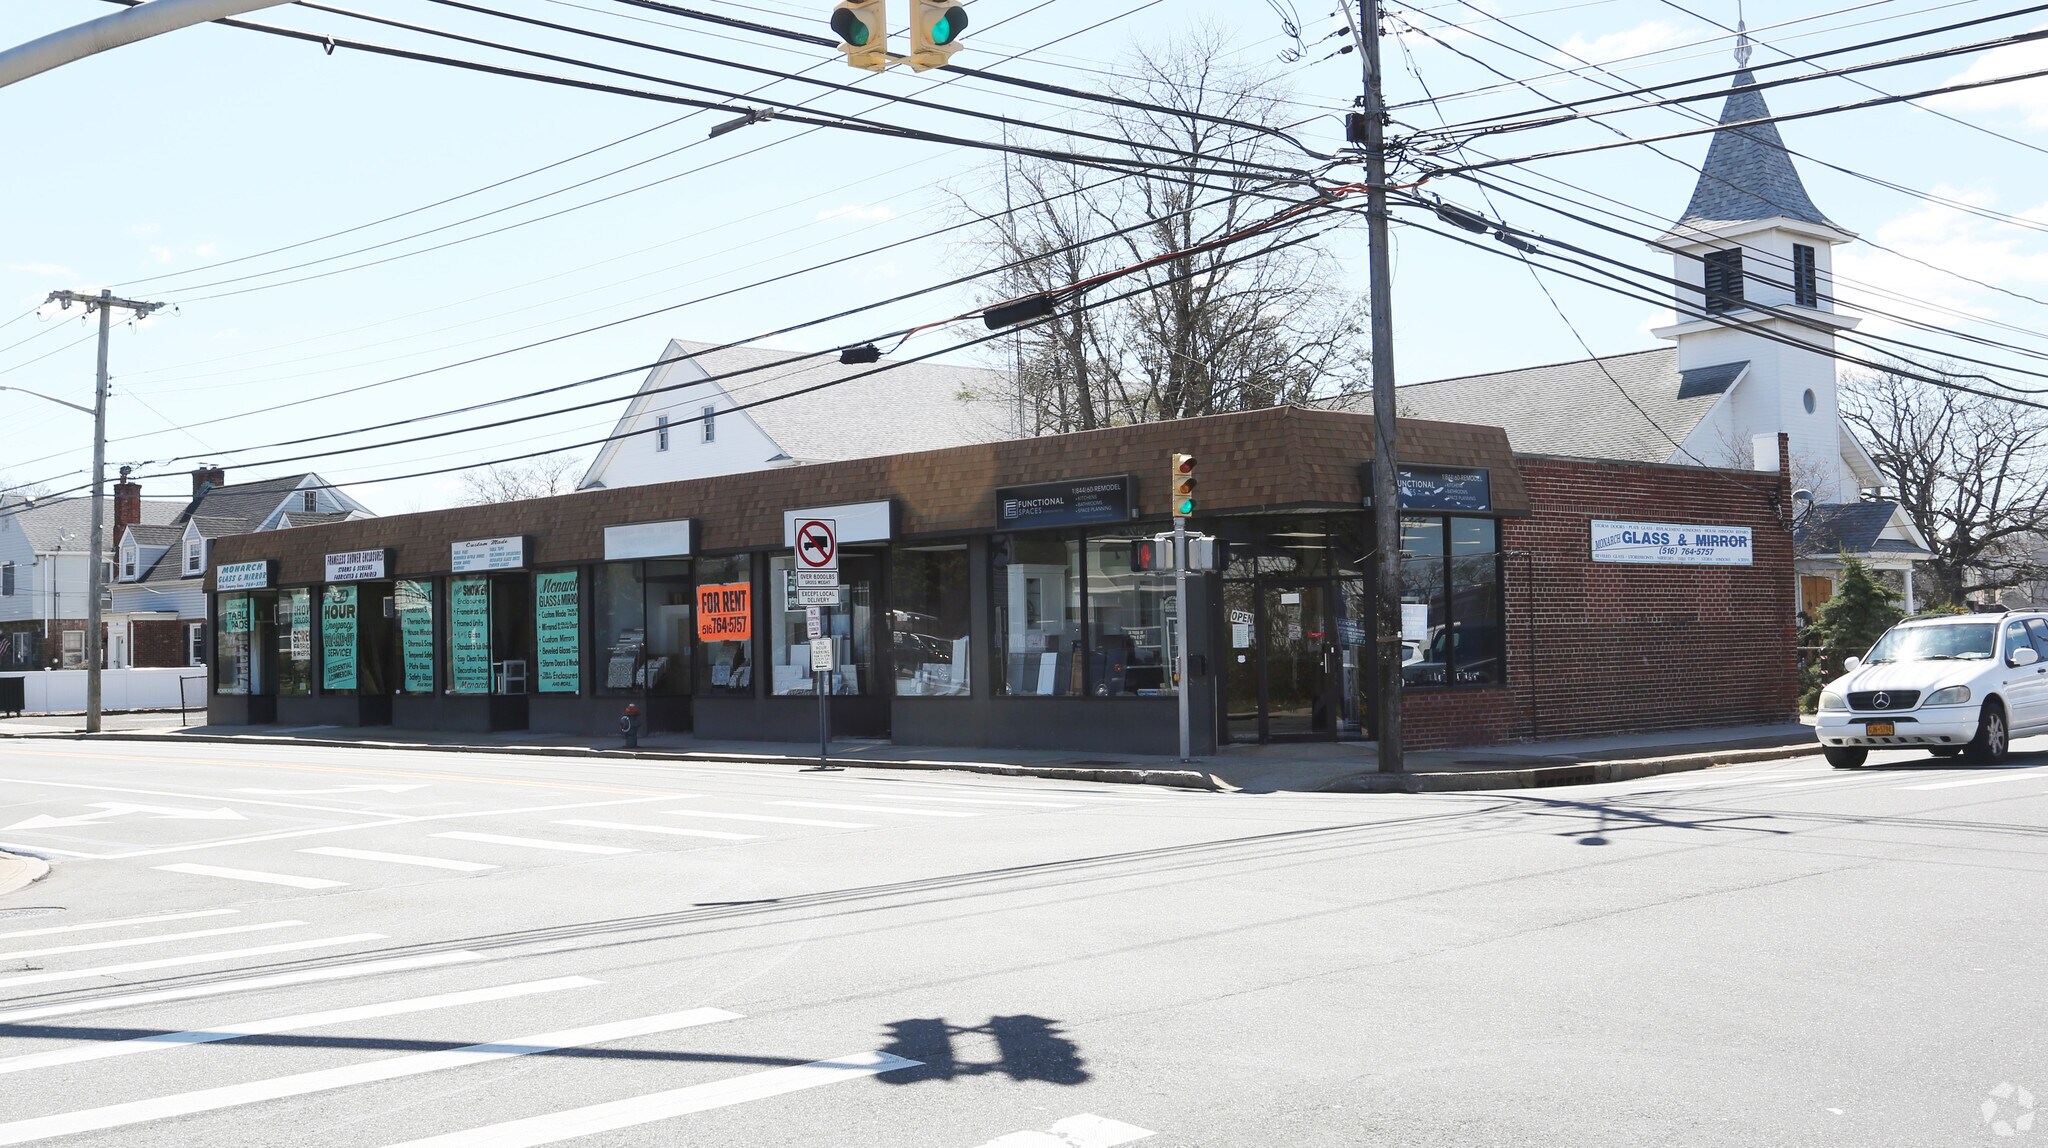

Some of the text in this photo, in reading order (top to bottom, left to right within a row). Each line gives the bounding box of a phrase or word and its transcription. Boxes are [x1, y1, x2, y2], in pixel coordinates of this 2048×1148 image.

[1397, 480, 1435, 489] UNCTIONAL
[1018, 497, 1064, 508] FUNCTIONAL
[1018, 507, 1042, 516] SPACES
[1595, 530, 1747, 550] MONARCH GLASS & MIRROR
[1659, 546, 1678, 555] (516)
[327, 551, 384, 566] FRAMELESS SHOWER ENCLOSURES
[222, 563, 263, 574] MONARCH
[218, 575, 236, 583] GLASS
[243, 572, 267, 581] MIRROR
[540, 578, 578, 593] Monarch
[539, 594, 557, 608] GLASS
[701, 590, 747, 614] FOR RENT
[324, 604, 356, 620] HOUR
[1231, 611, 1254, 624] OPEN
[325, 621, 354, 633] Emergency
[473, 619, 483, 627] Units
[702, 624, 712, 635] 516
[542, 647, 558, 655] Beveled
[559, 646, 571, 654] Glass
[327, 661, 352, 674] RESIDENTIAL
[409, 662, 430, 670] Plate Glass
[554, 659, 566, 667] Doors
[457, 666, 477, 674] Decorative
[409, 674, 421, 683] Safety
[553, 672, 578, 680] Enclosures
